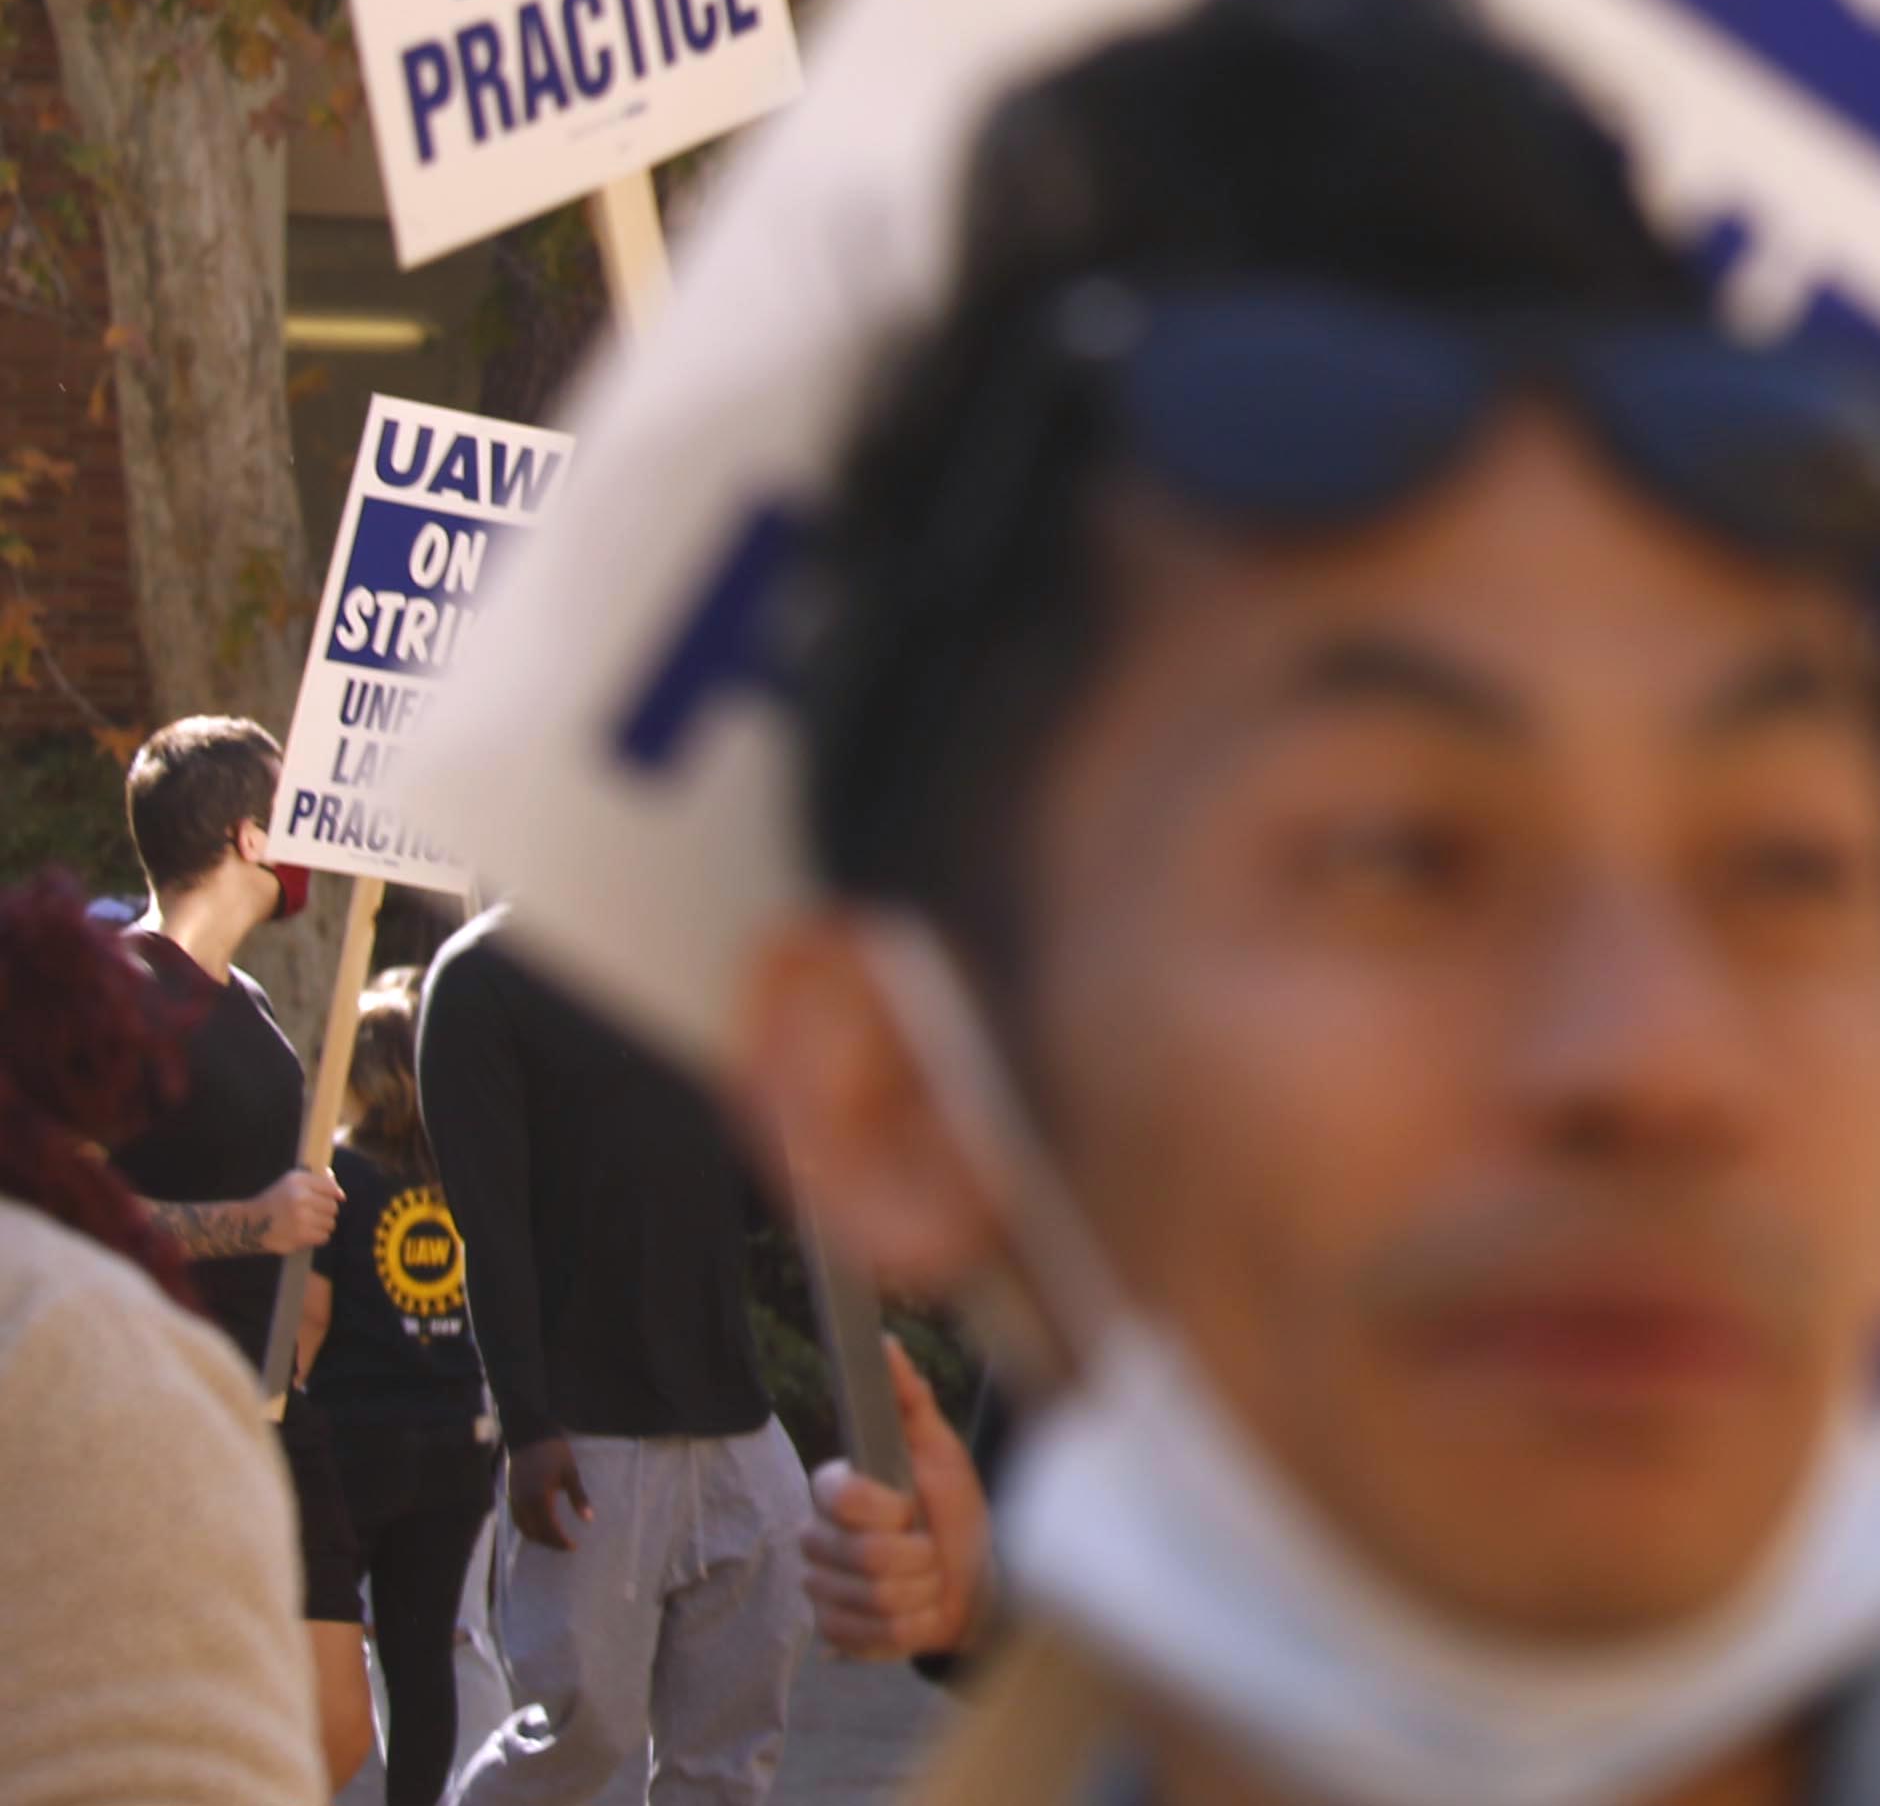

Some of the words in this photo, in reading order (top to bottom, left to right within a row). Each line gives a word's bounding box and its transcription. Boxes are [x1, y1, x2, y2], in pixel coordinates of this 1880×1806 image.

[374, 418, 562, 513] UAW
[409, 522, 487, 594] ON
[336, 585, 480, 668] STRI
[404, 1237, 450, 1267] UAW
